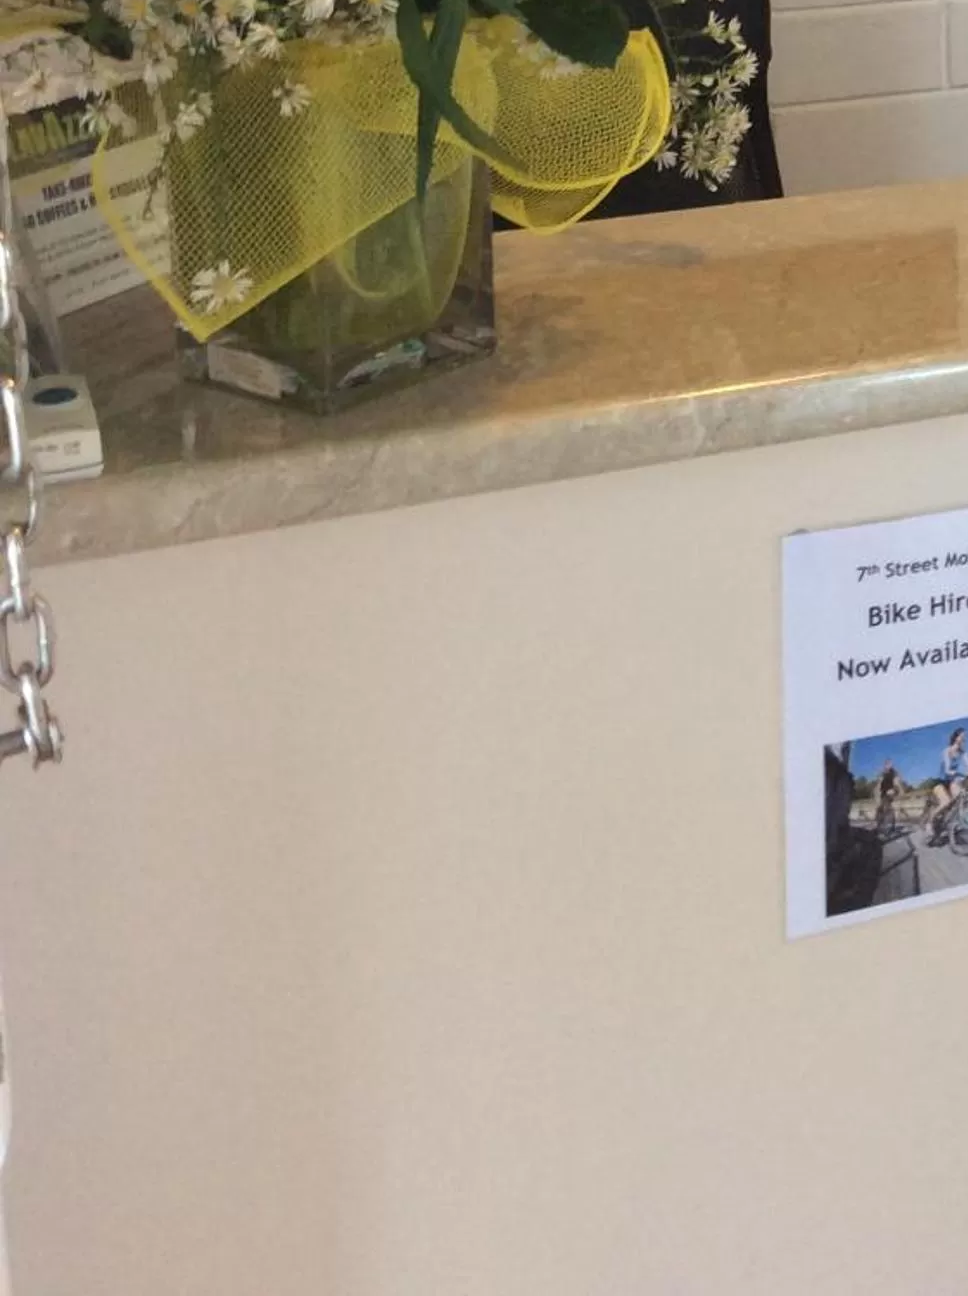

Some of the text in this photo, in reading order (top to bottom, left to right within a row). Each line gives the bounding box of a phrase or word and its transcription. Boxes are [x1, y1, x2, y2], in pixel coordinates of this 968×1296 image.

[856, 565, 880, 582] 7th
[885, 557, 939, 578] Street
[868, 602, 921, 628] Bike
[837, 657, 892, 681] Now
